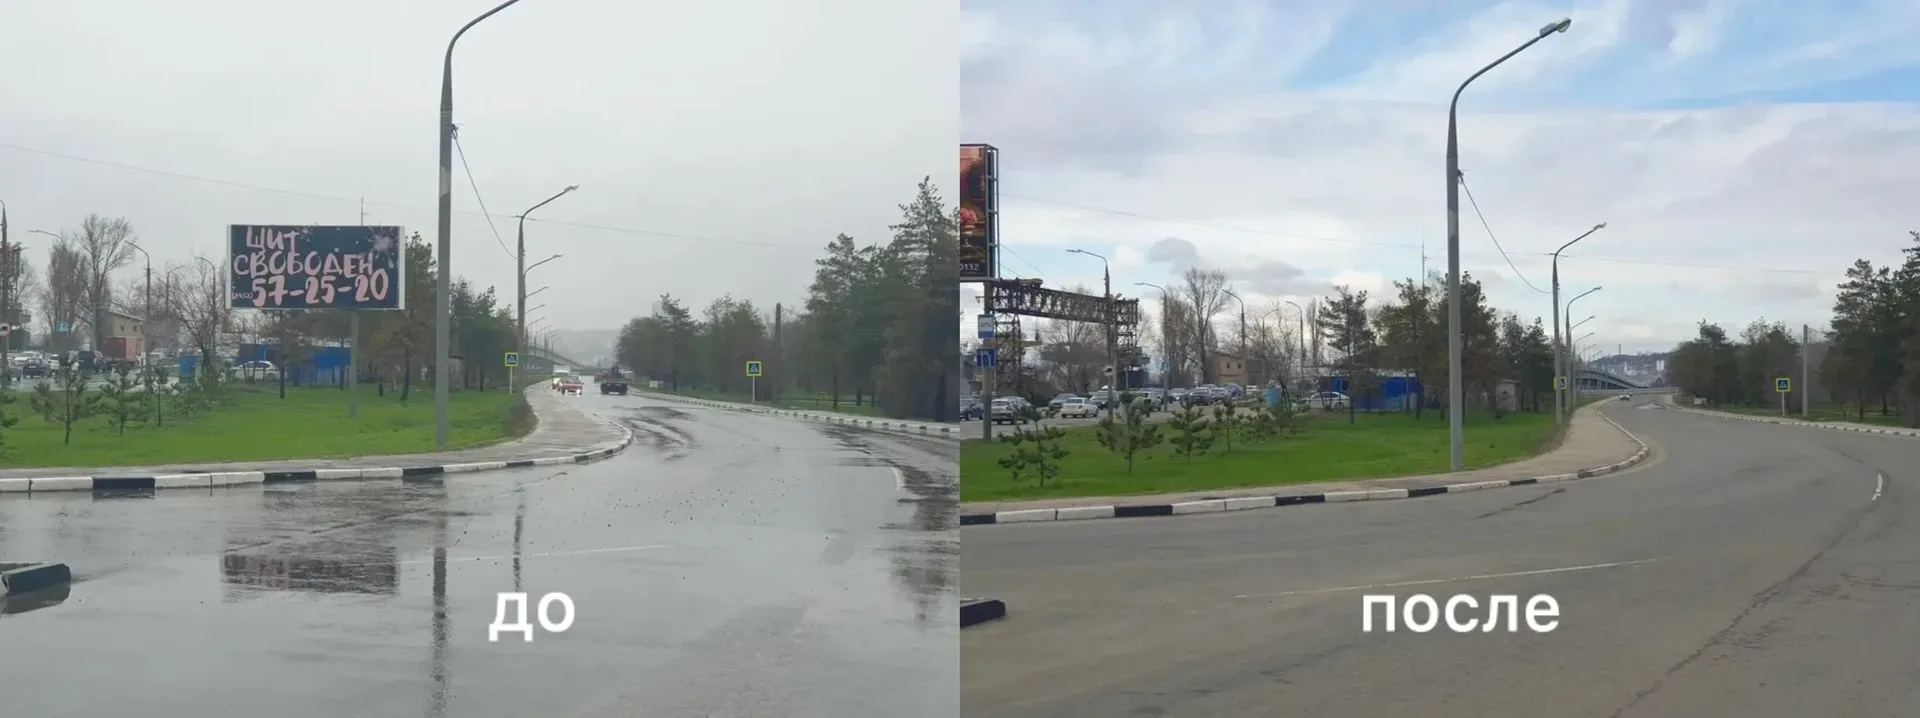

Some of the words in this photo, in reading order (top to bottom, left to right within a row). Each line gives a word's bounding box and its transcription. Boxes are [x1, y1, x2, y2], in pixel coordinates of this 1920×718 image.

[246, 226, 300, 255] ЩИТ
[233, 249, 374, 279] СВОБОДЕН
[252, 268, 389, 307] 57-25-20
